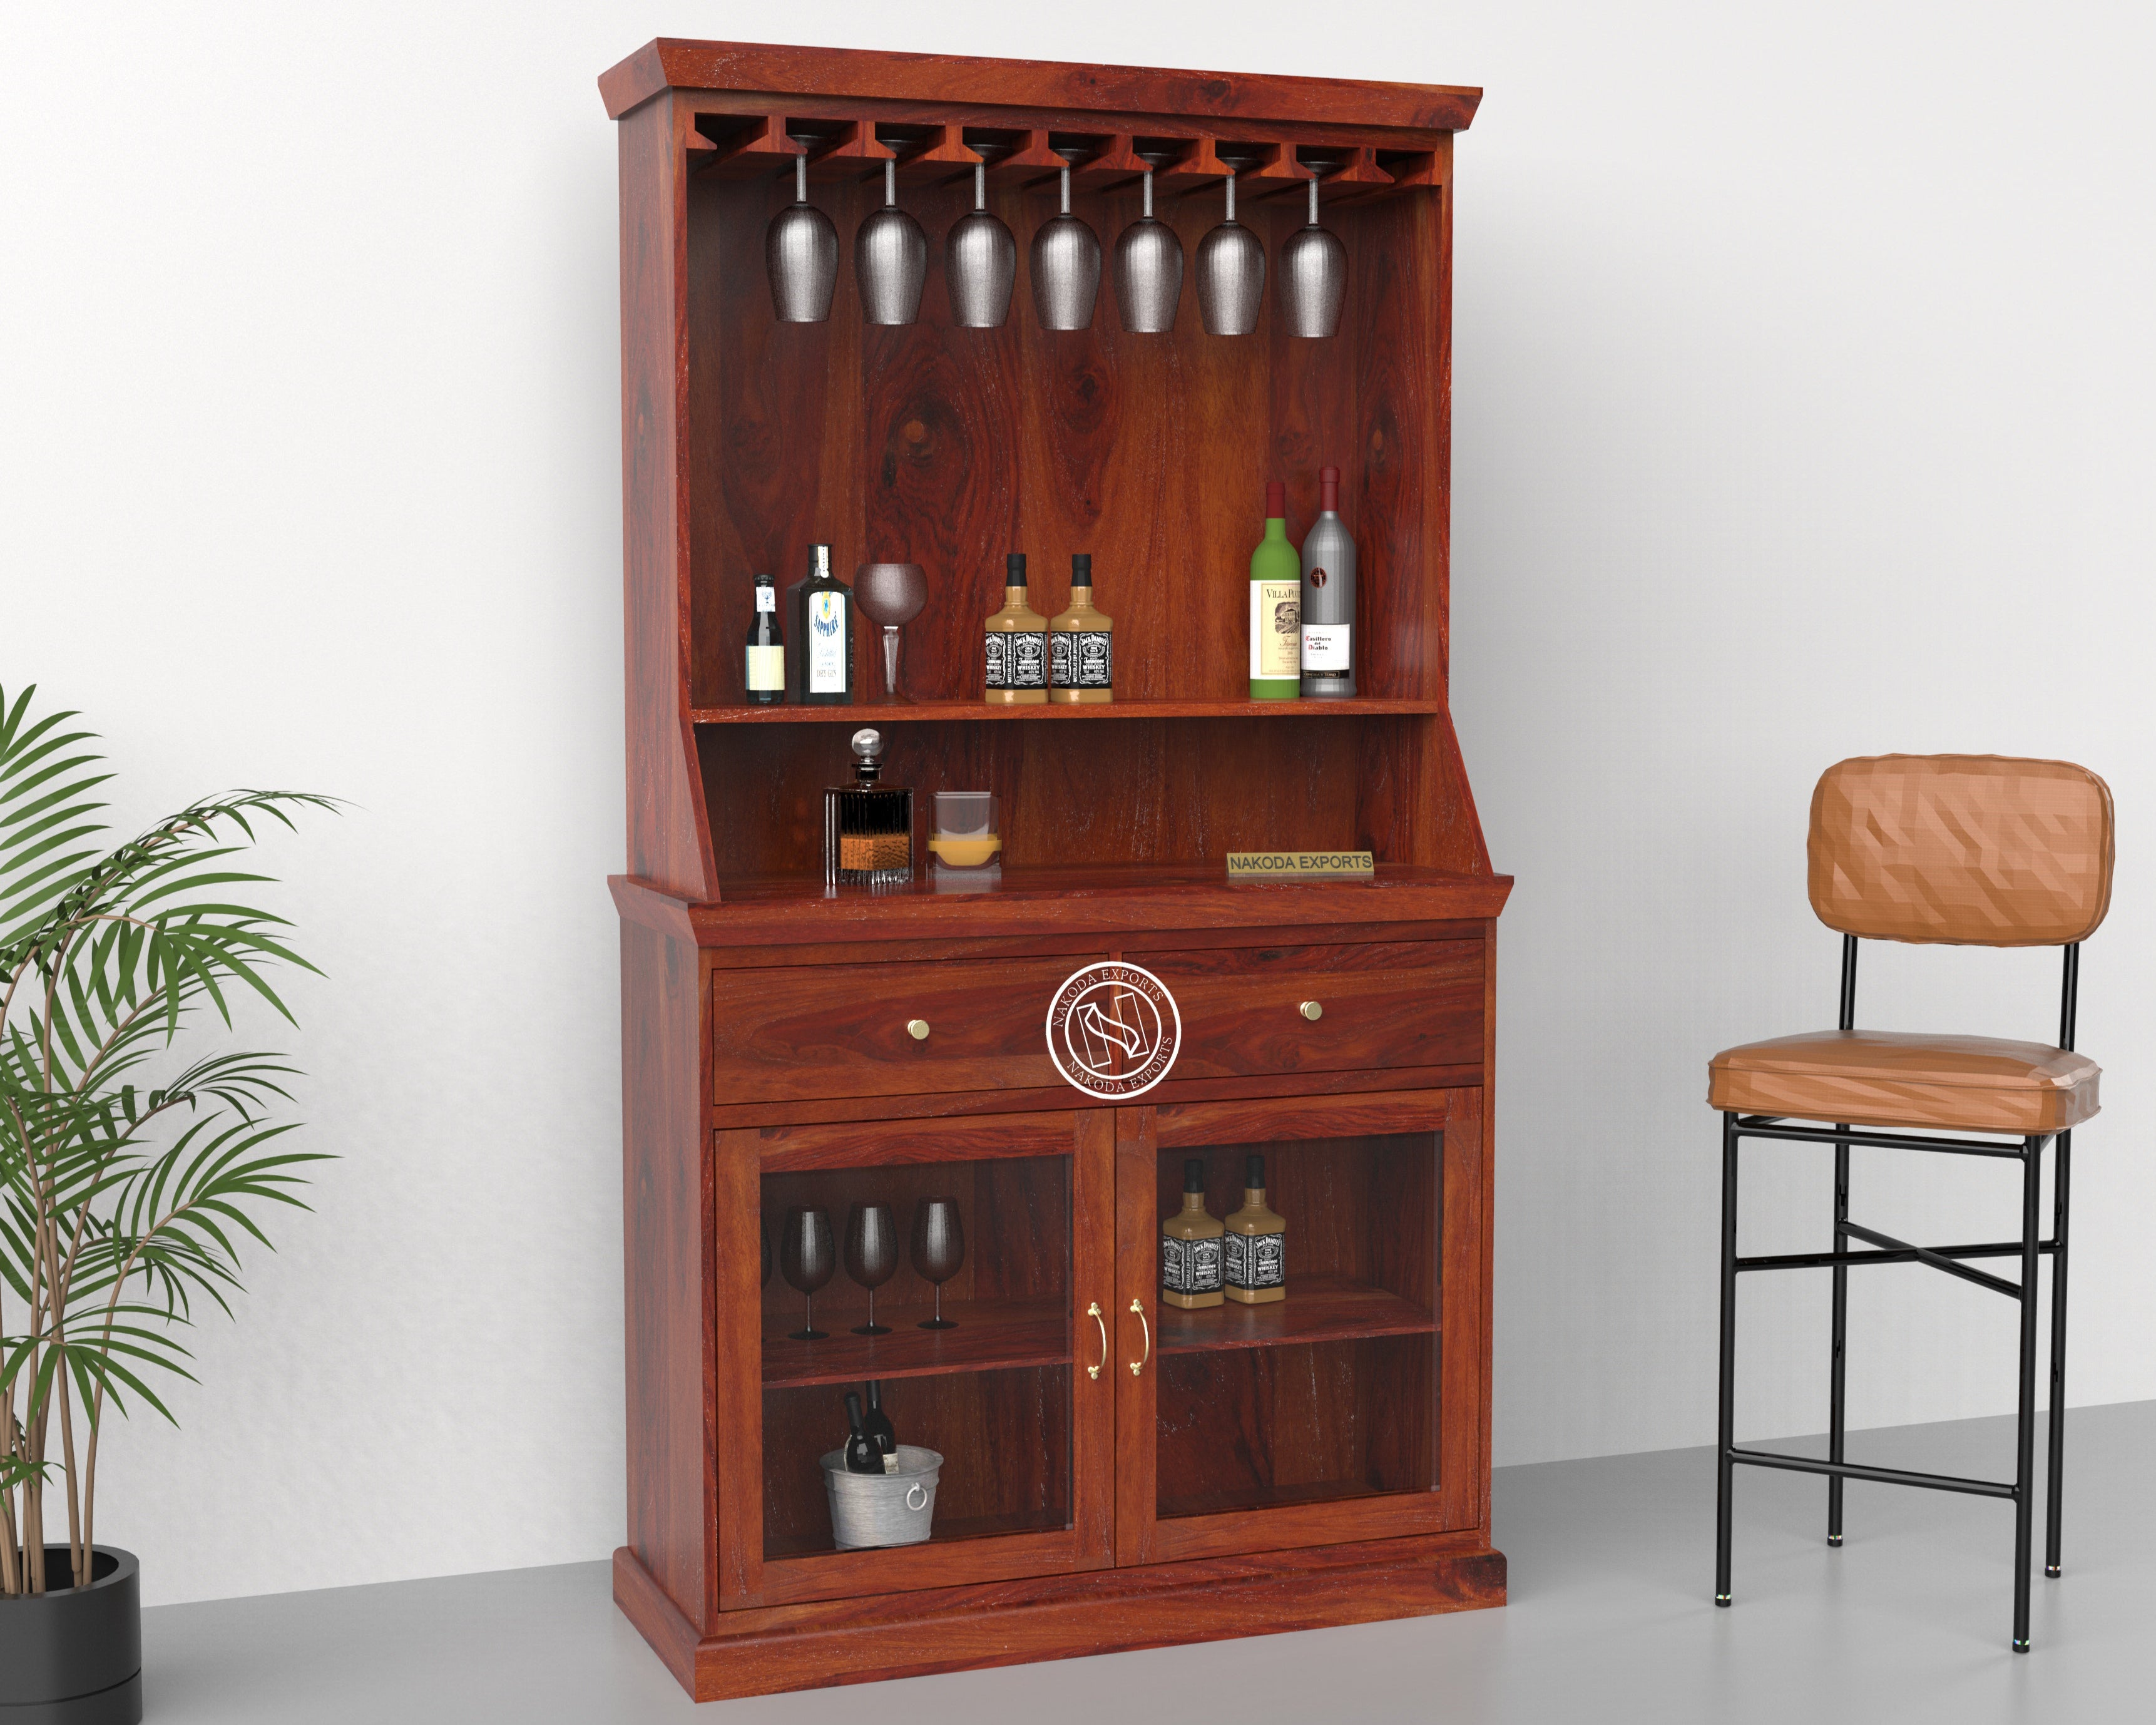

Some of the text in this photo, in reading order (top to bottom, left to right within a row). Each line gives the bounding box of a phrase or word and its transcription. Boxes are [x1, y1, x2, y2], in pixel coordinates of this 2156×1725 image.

[1267, 589, 1287, 598] VILLA
[814, 614, 839, 637] SAPPHIRE
[1015, 637, 1026, 646] JACK
[1081, 637, 1091, 646] JACK
[1230, 855, 1372, 870] NAKODA EXPORTS
